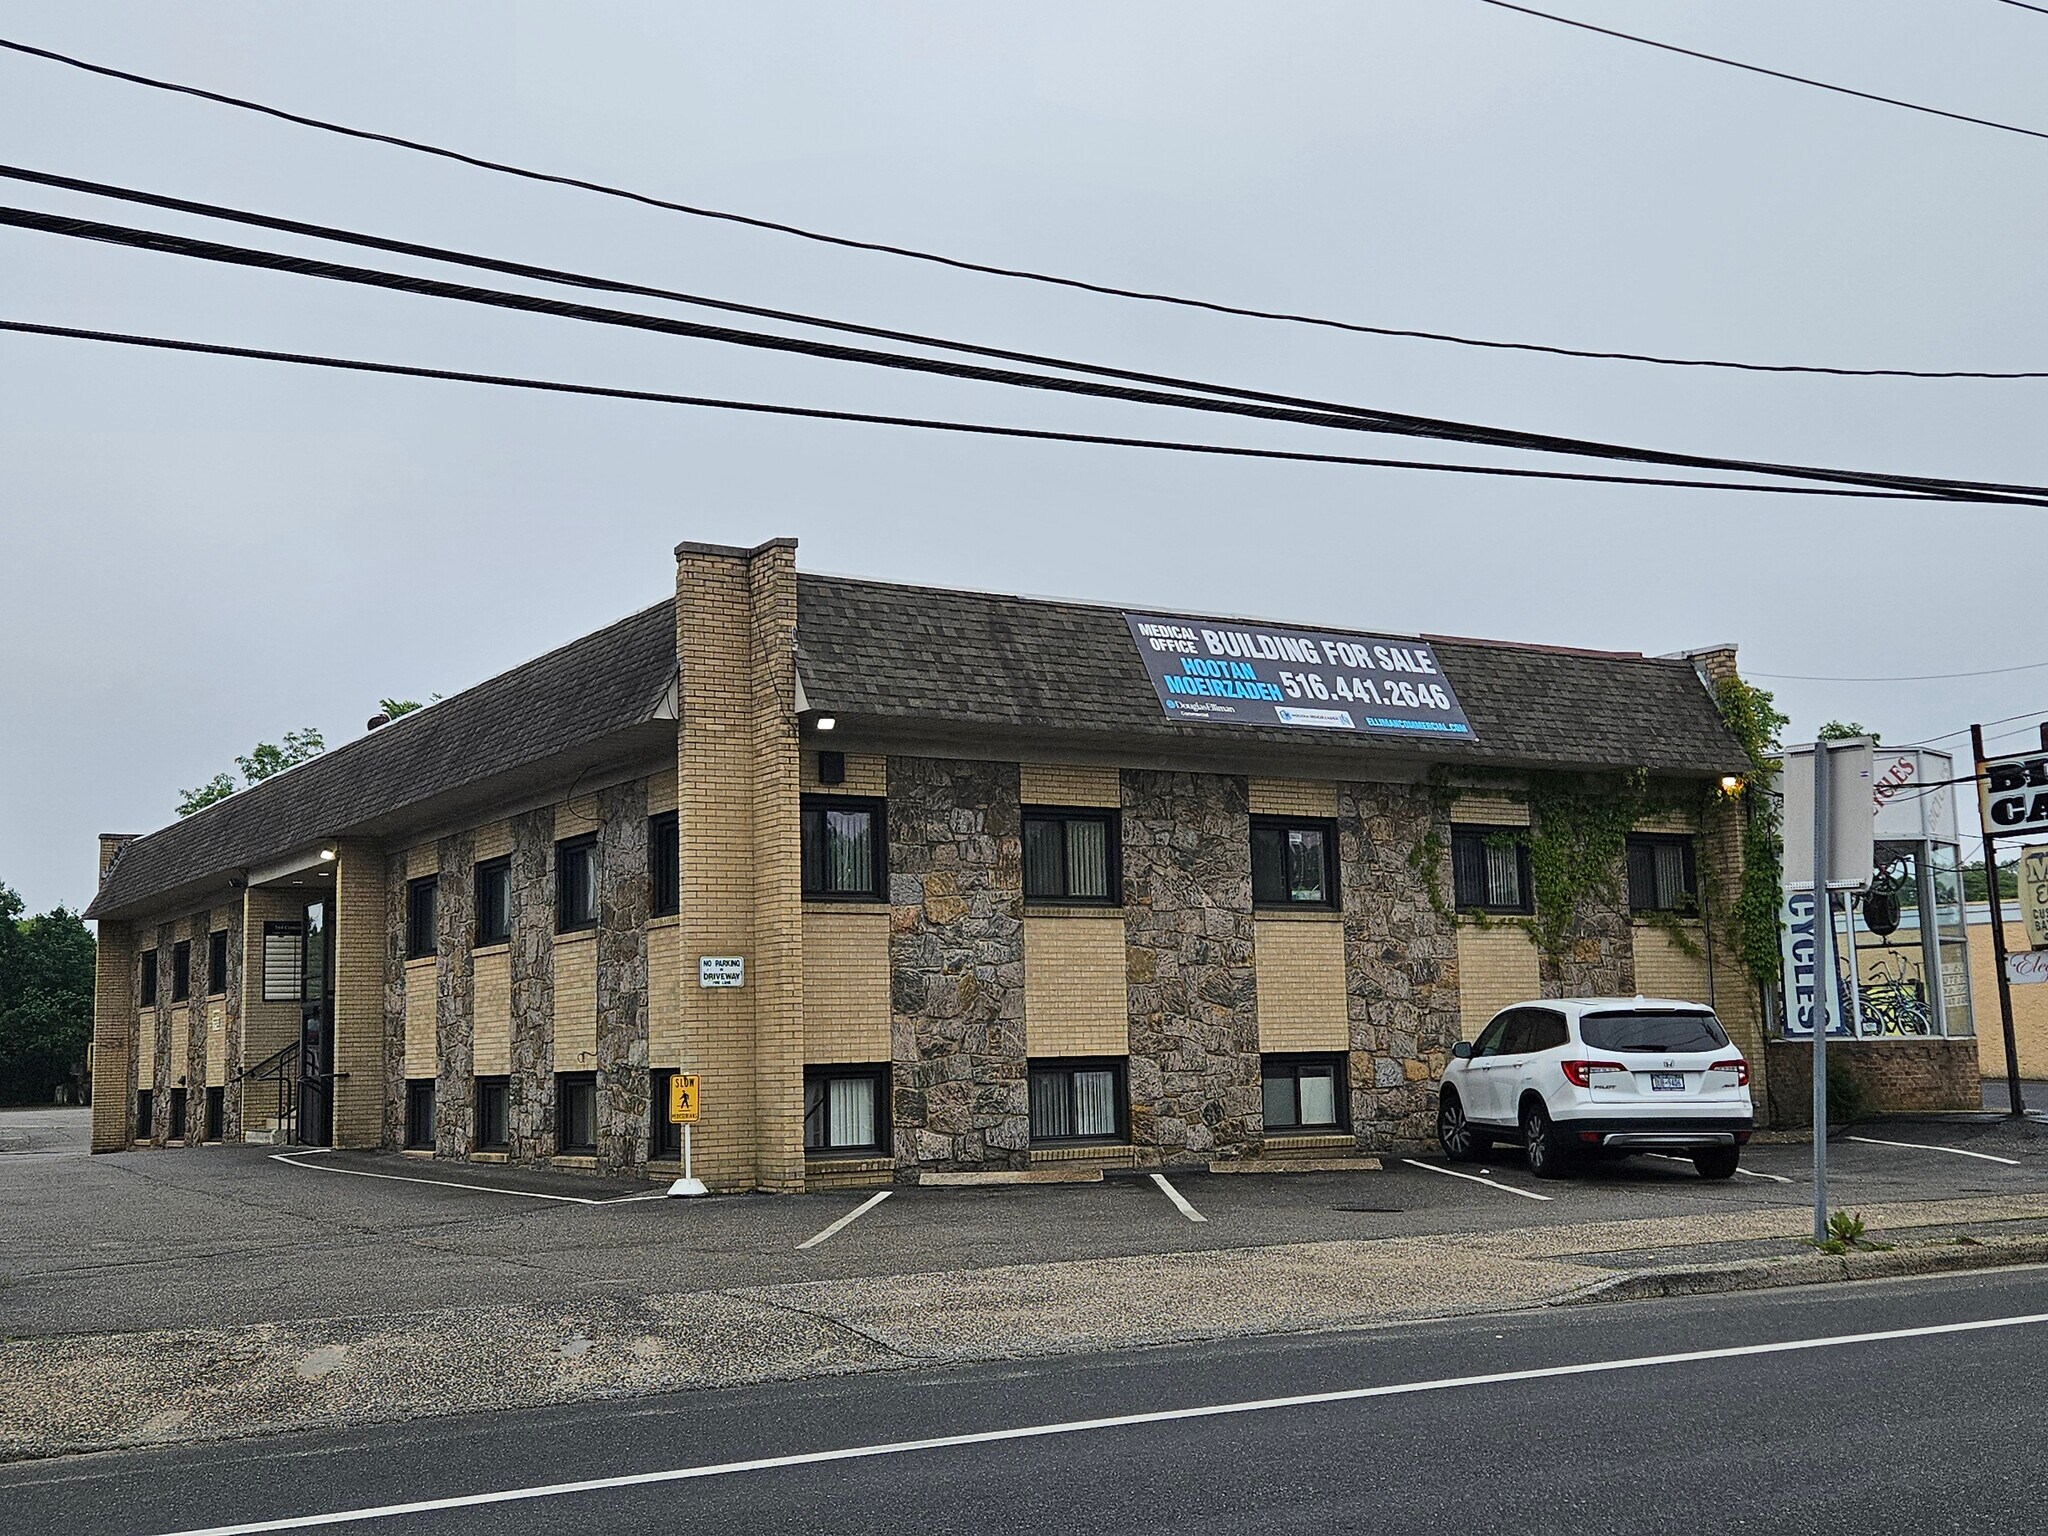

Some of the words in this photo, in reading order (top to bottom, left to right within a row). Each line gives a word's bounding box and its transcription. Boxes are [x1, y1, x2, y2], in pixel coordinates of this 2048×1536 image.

[1138, 623, 1199, 641] MEDICAL
[1149, 638, 1199, 654] OFFICE
[1200, 629, 1322, 665] BUILDING
[1320, 640, 1375, 669] FOR
[1373, 645, 1437, 675] SALE
[1180, 657, 1257, 681] HOOTAN
[1163, 675, 1285, 702] MOEIRZADEH
[1278, 671, 1451, 711] 516.441.2646
[1365, 716, 1468, 733] ELLIMANCOMMERCIAL.COM
[1873, 756, 1916, 816] YCLES
[703, 959, 712, 967] NO
[715, 959, 740, 967] PARKING
[703, 972, 740, 981] DRIVEWAY
[675, 1078, 695, 1088] SLOW
